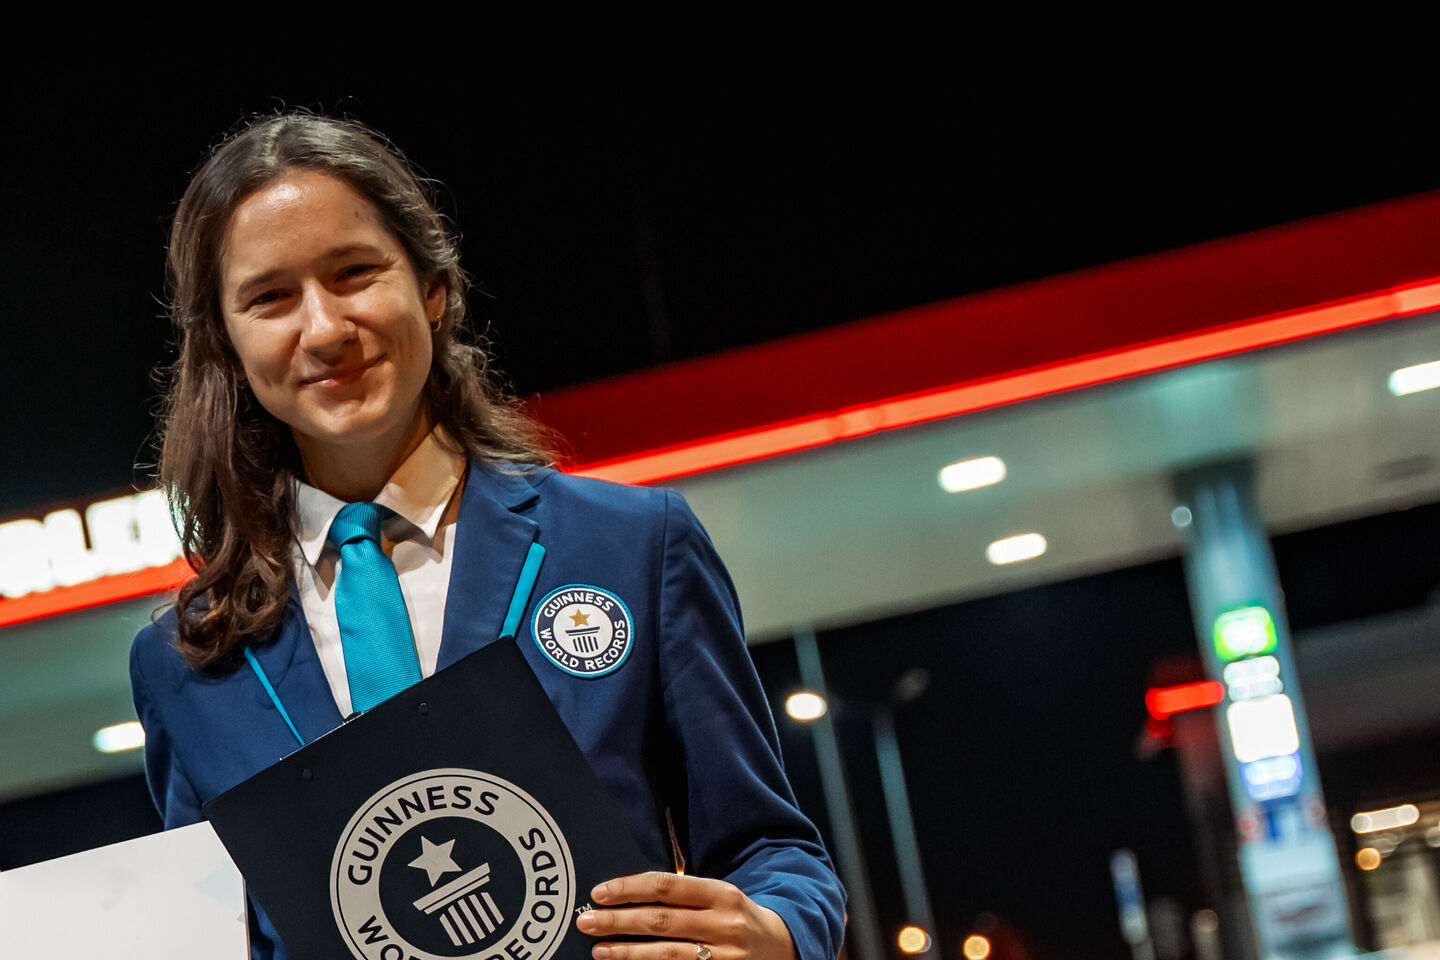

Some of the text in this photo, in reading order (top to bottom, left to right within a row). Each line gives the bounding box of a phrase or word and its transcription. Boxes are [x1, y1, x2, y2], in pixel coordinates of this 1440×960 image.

[544, 592, 614, 618] GUINNESS
[540, 620, 625, 671] WORLD RECORDS
[347, 785, 500, 886] GUINNESS
